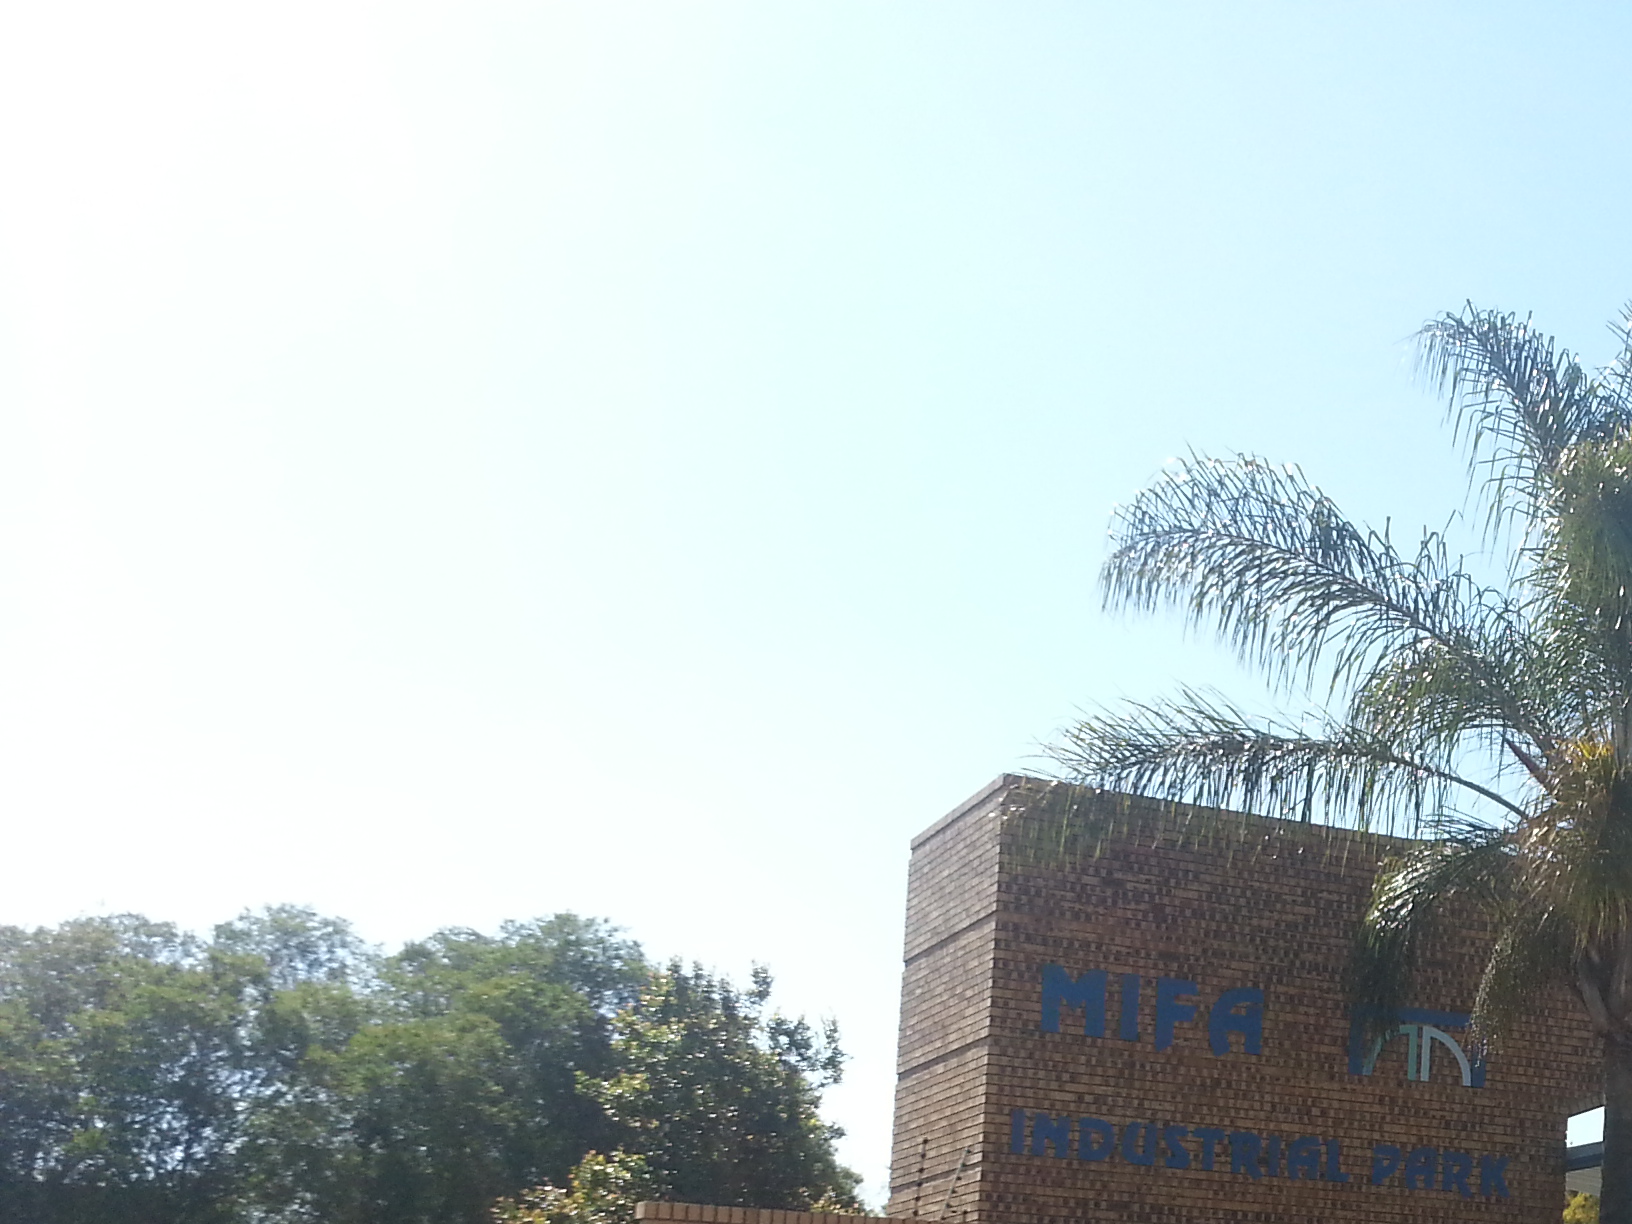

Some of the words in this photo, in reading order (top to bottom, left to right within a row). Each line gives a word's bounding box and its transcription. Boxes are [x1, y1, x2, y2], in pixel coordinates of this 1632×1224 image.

[1040, 963, 1266, 1056] MIFA
[1010, 1108, 1351, 1184] INDUSTRIAL
[1371, 1144, 1512, 1199] PARK
